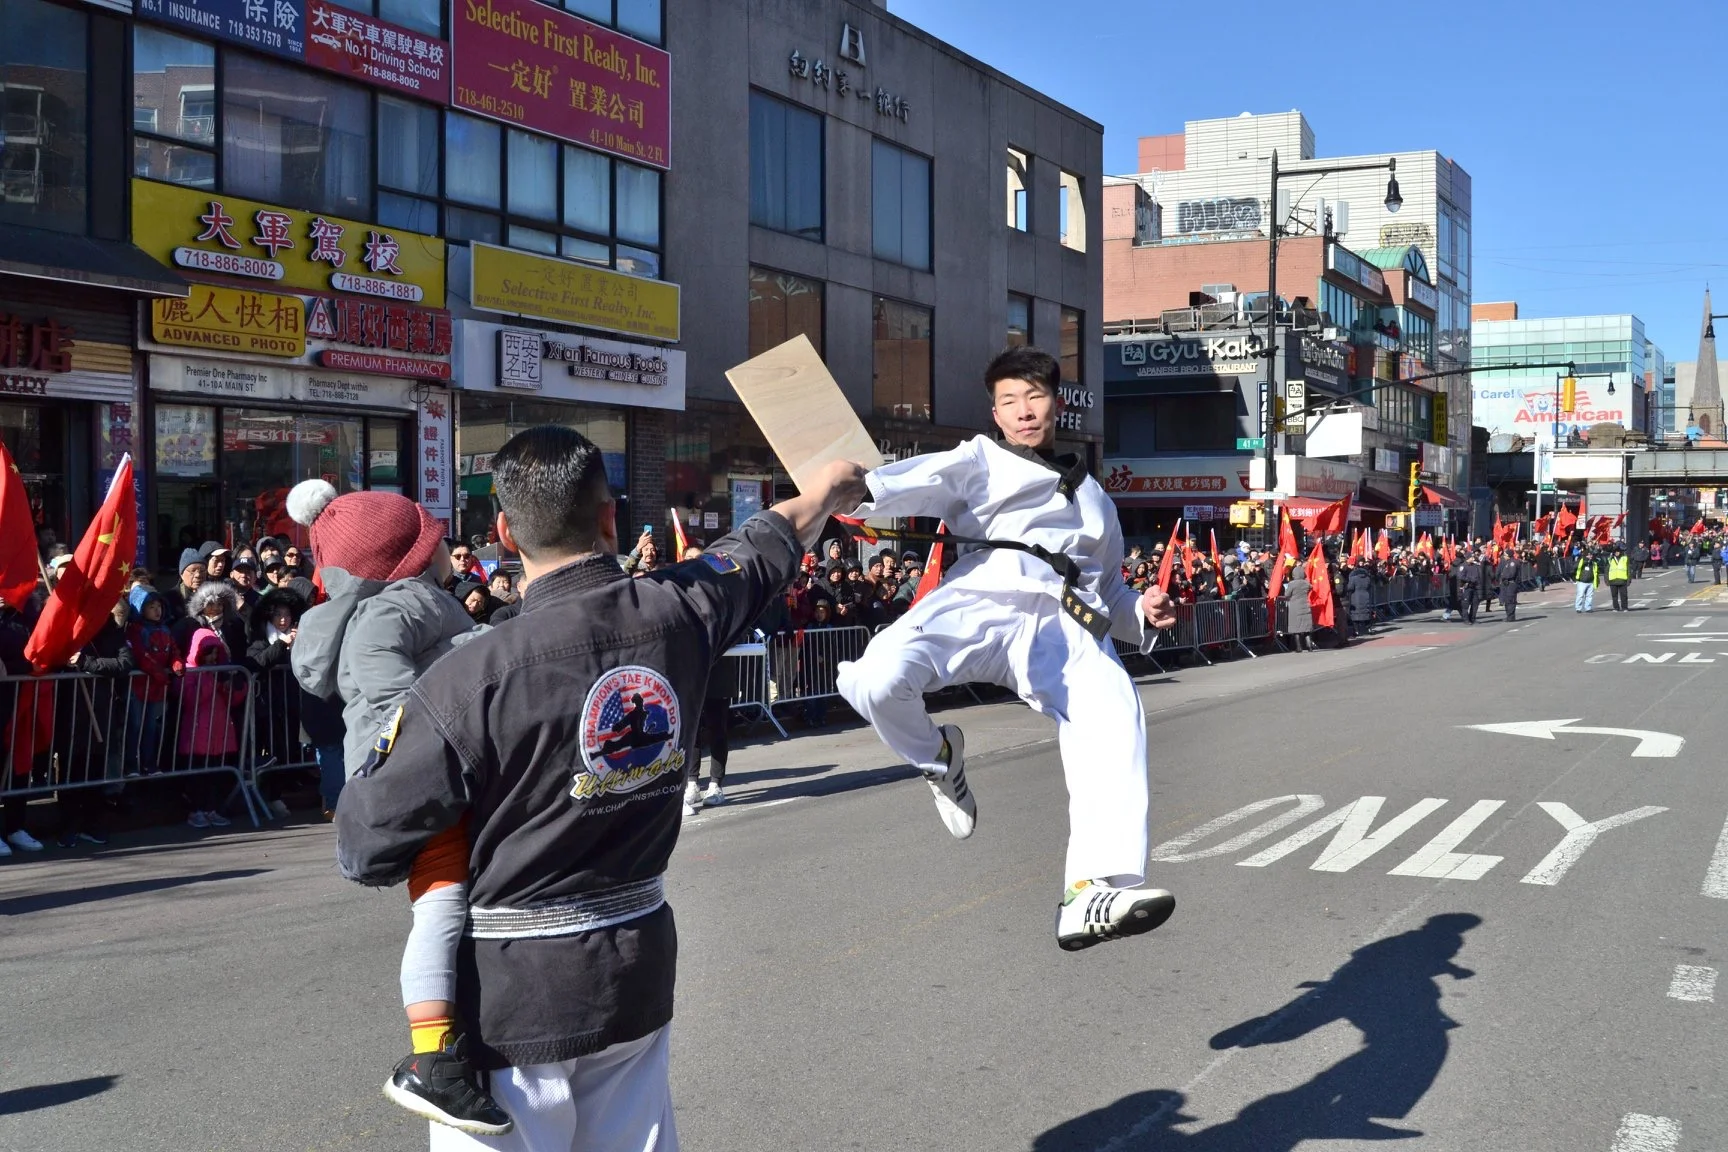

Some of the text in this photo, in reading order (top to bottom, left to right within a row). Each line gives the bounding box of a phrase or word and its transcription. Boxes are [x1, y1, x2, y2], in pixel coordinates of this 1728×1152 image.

[168, 2, 221, 30] INSURANCE
[228, 19, 244, 37] 718
[245, 25, 260, 42] 353
[262, 29, 282, 49] 7578
[312, 6, 444, 66] 大軍汽車駕駛學校
[465, 0, 661, 89] Selective First Realty, Inc.
[345, 38, 440, 80] No.1 Driving School
[362, 63, 420, 90] 718-886-8002
[457, 86, 525, 122] 718-461-2510
[569, 77, 645, 130] 置業公司
[616, 134, 635, 155] Main
[636, 141, 648, 158] St.
[648, 145, 655, 161] 2
[197, 201, 403, 275] 大軍駕校
[183, 249, 277, 279] 718-886-8002
[339, 274, 417, 301] 718-886-1881
[501, 279, 656, 321] Selective First Realty, Inc.
[163, 327, 297, 353] ADVANCED PHOTO
[330, 352, 444, 376] PREMIUM PHARMACY
[549, 341, 668, 373] Xi'an Famous Foods
[1137, 362, 1258, 377] JAPANESE BBQ RESTAURANT
[186, 365, 268, 384] Premier One Pharmacy Inc
[224, 381, 244, 393] MAIN
[245, 383, 256, 393] ST.
[308, 377, 336, 391] Pharmacy
[573, 365, 668, 386] WESTERN CHINESE CUISINE
[1480, 389, 1515, 399] Care!
[1514, 409, 1623, 424] American
[1242, 440, 1251, 448] 41
[620, 673, 642, 685] TAE
[669, 706, 677, 725] DO
[1150, 794, 1670, 885] ONLY
